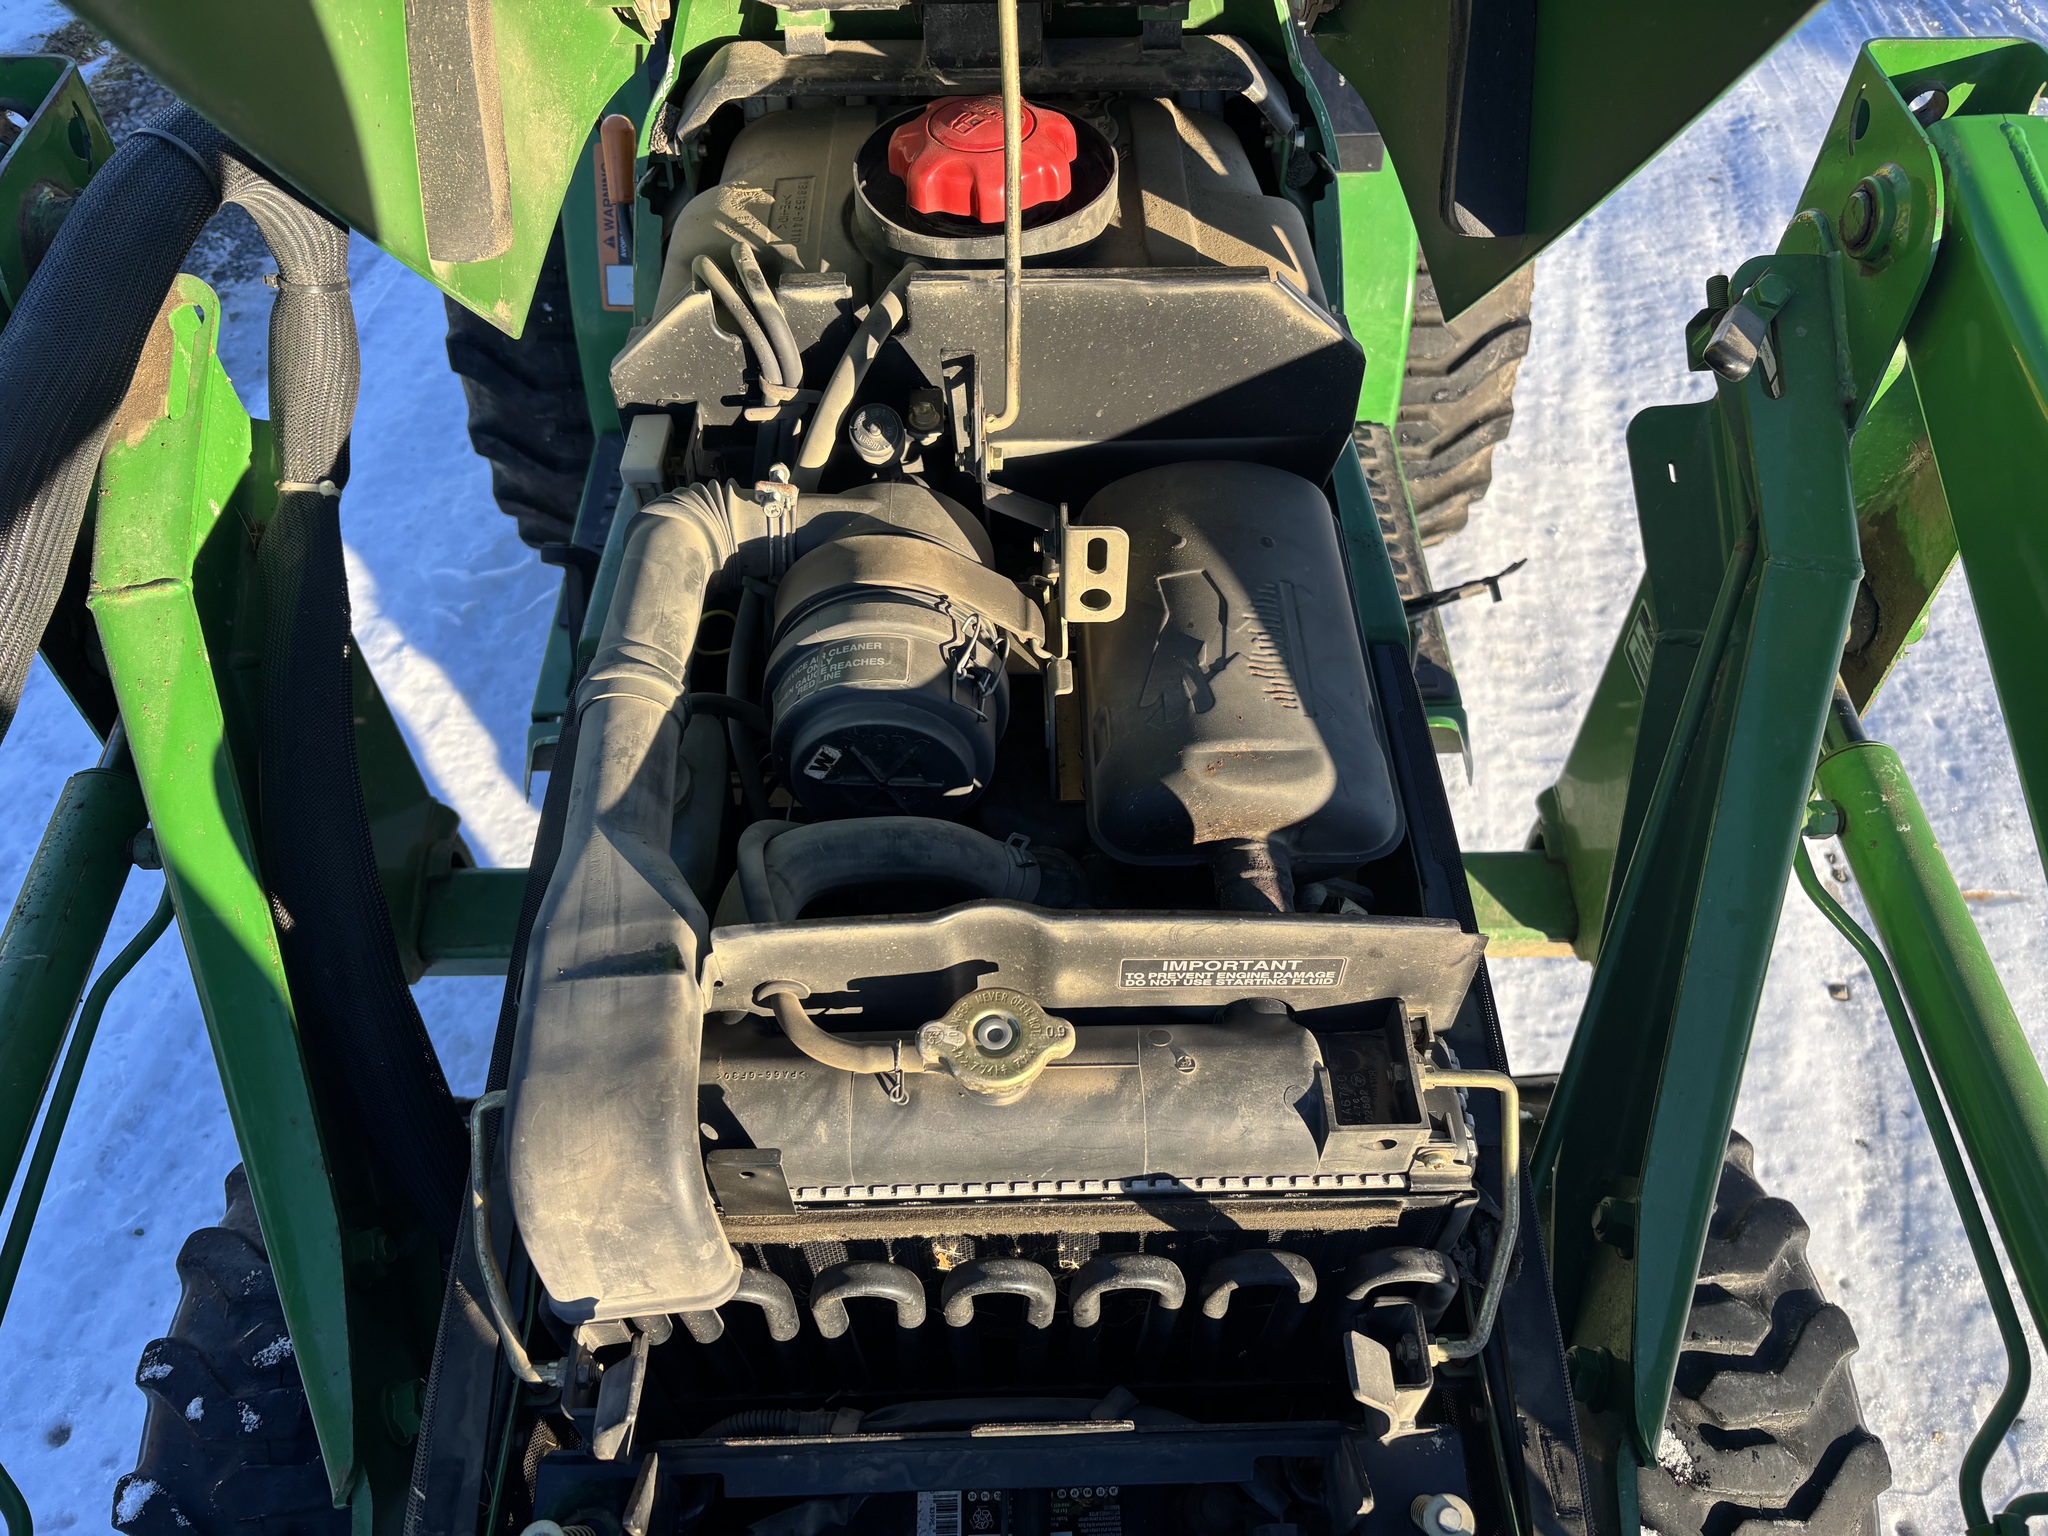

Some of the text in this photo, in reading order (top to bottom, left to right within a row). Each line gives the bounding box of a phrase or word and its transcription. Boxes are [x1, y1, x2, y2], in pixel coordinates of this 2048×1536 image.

[828, 642, 883, 657] CLEANER
[806, 657, 833, 674] ONLY
[830, 657, 885, 672] REACHES
[796, 681, 816, 697] RED
[1162, 960, 1303, 971] IMPORTANT
[1125, 971, 1336, 980] TO PREVENT ENGINE DAMAGE
[1188, 978, 1212, 986] USE
[1215, 978, 1288, 986] STARTING
[1291, 977, 1334, 985] FLUID
[974, 991, 1009, 1004] NEVER
[1045, 1025, 1067, 1038] 0.9
